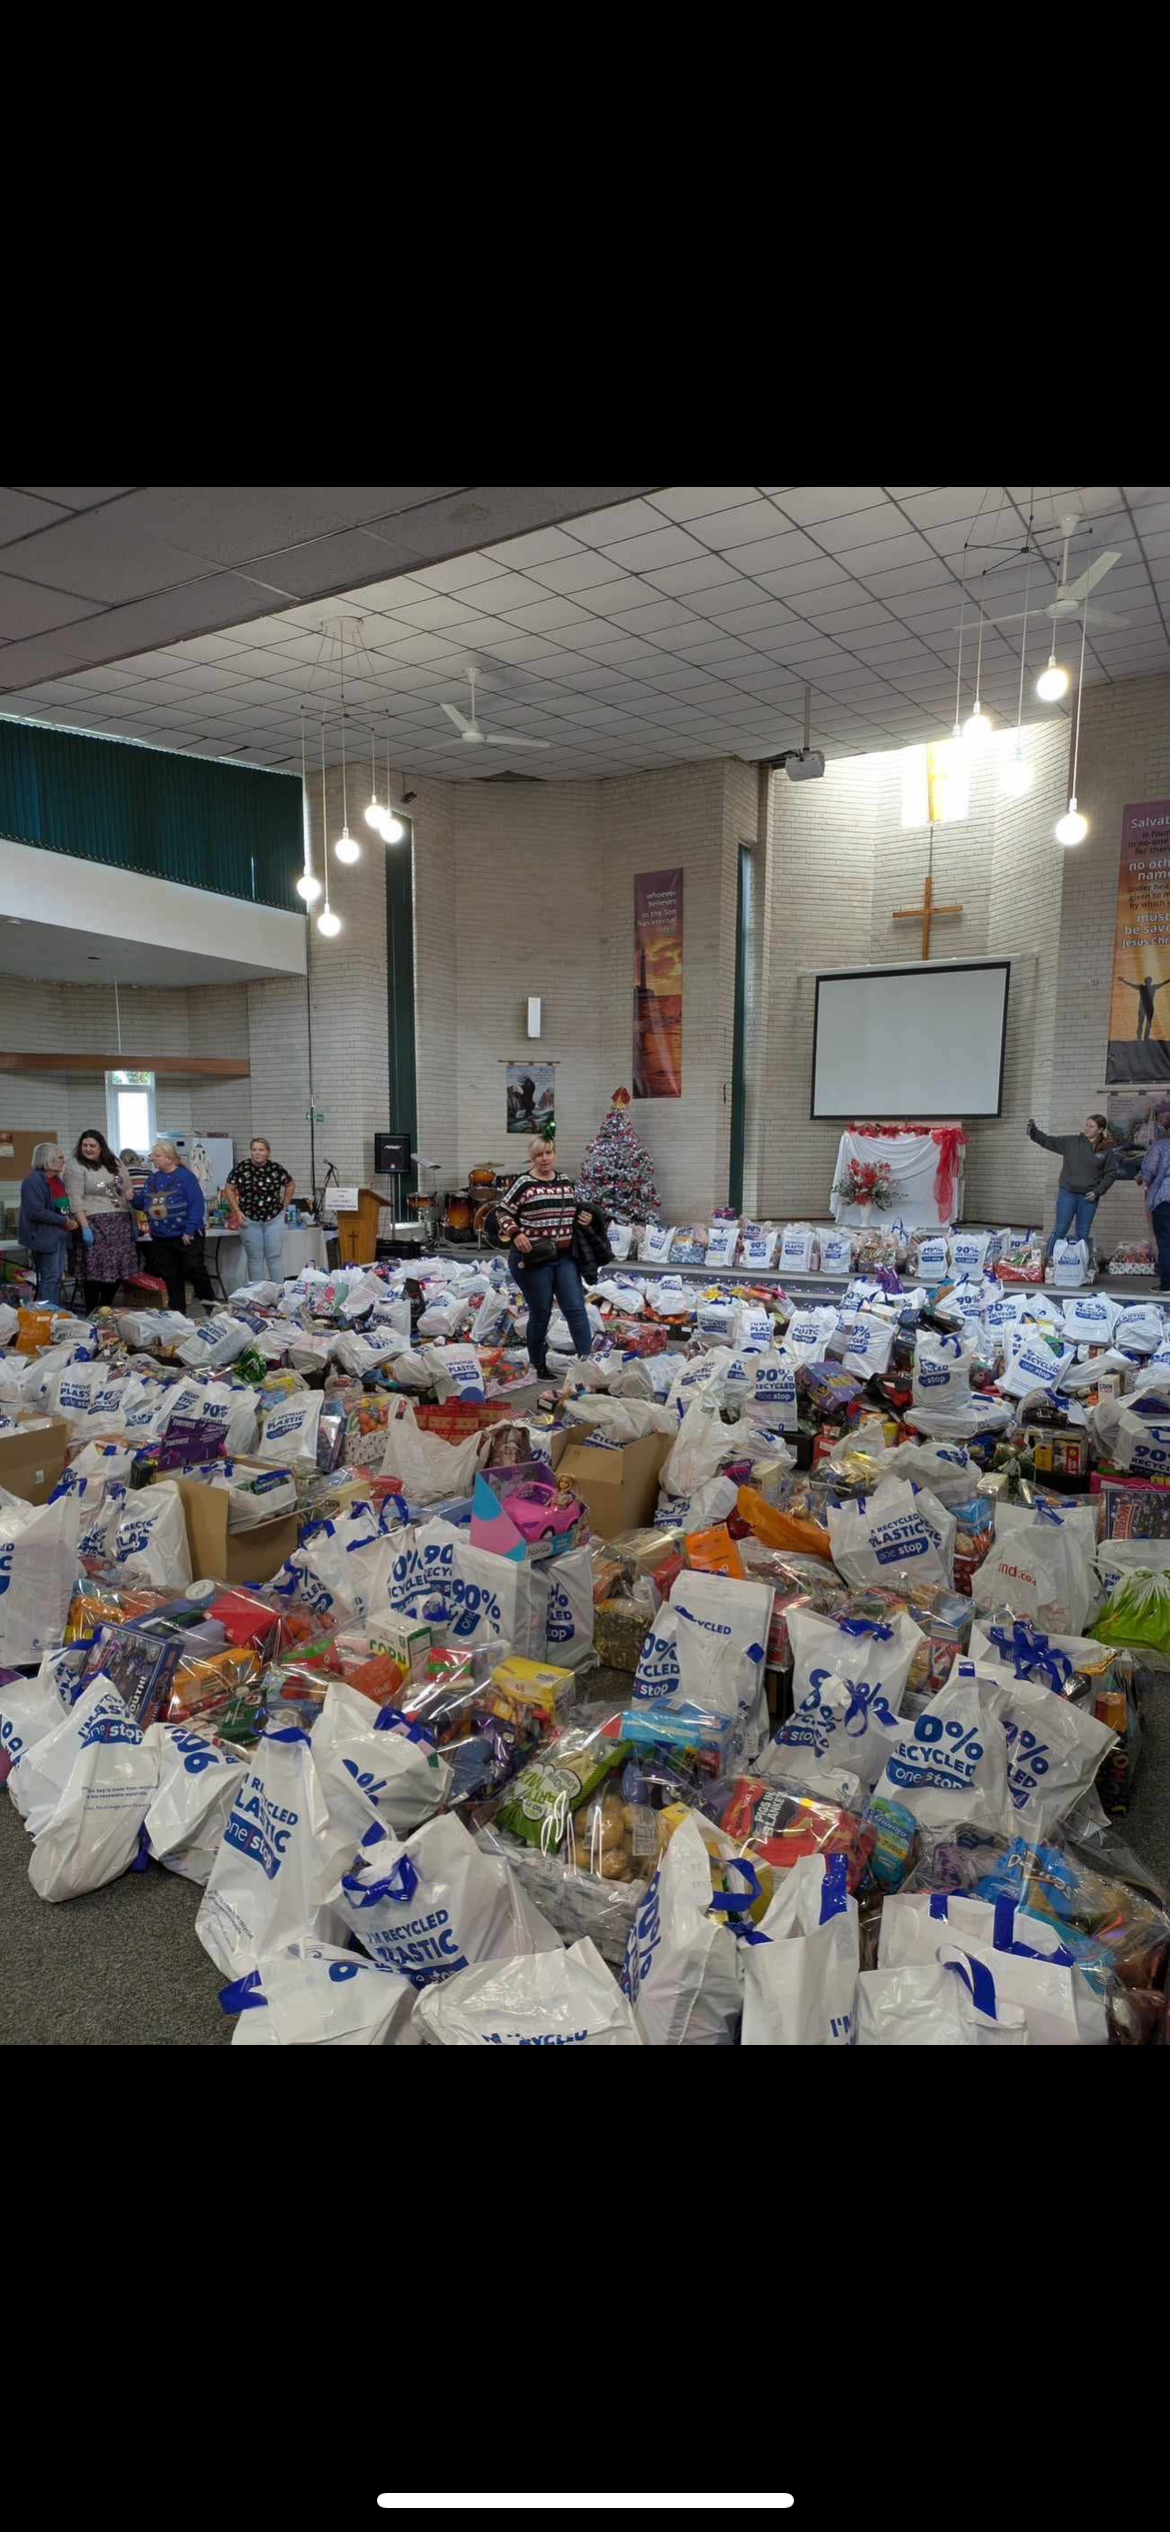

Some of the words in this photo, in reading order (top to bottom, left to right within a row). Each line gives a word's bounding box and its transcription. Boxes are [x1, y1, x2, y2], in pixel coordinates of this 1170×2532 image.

[1129, 862, 1145, 871] no
[646, 890, 677, 900] whoever
[1129, 893, 1150, 902] given
[1129, 902, 1139, 910] by
[1142, 901, 1165, 909] which
[650, 910, 662, 918] the
[664, 908, 677, 916] Son
[1137, 913, 1170, 923] must
[651, 917, 677, 926] eternal
[1124, 925, 1139, 935] be
[1122, 938, 1148, 948] Jesus
[988, 1303, 1016, 1313] 90%
[851, 1326, 870, 1339] 0%
[448, 1365, 476, 1373] PLASTIC
[1022, 1354, 1058, 1374] RECYCLED
[756, 1369, 793, 1381] 90%
[927, 1376, 945, 1385] stop
[1035, 1369, 1050, 1380] stop
[773, 1391, 790, 1401] stop
[203, 1402, 231, 1418] 90%
[267, 1414, 305, 1429] PLASTIC
[1135, 1445, 1170, 1462] 90
[877, 1513, 919, 1532] RECYCLED
[868, 1522, 924, 1548] PLASTIC
[880, 1549, 896, 1560] one
[898, 1542, 922, 1555] stop
[388, 1549, 424, 1583] 0%
[452, 1579, 501, 1620] 90%
[462, 1611, 477, 1630] one
[641, 1684, 668, 1696] stop
[109, 1724, 145, 1743] stop
[914, 1714, 984, 1761] 0%
[895, 1768, 922, 1782] one
[252, 1777, 298, 1825] RCLED
[754, 1801, 771, 1823] PIGS
[763, 1791, 777, 1801] IN
[234, 1788, 291, 1853] LATIC
[251, 1838, 272, 1869] stop
[382, 1910, 449, 1943] RECYCLED
[376, 1929, 459, 1966] PLASTIC
